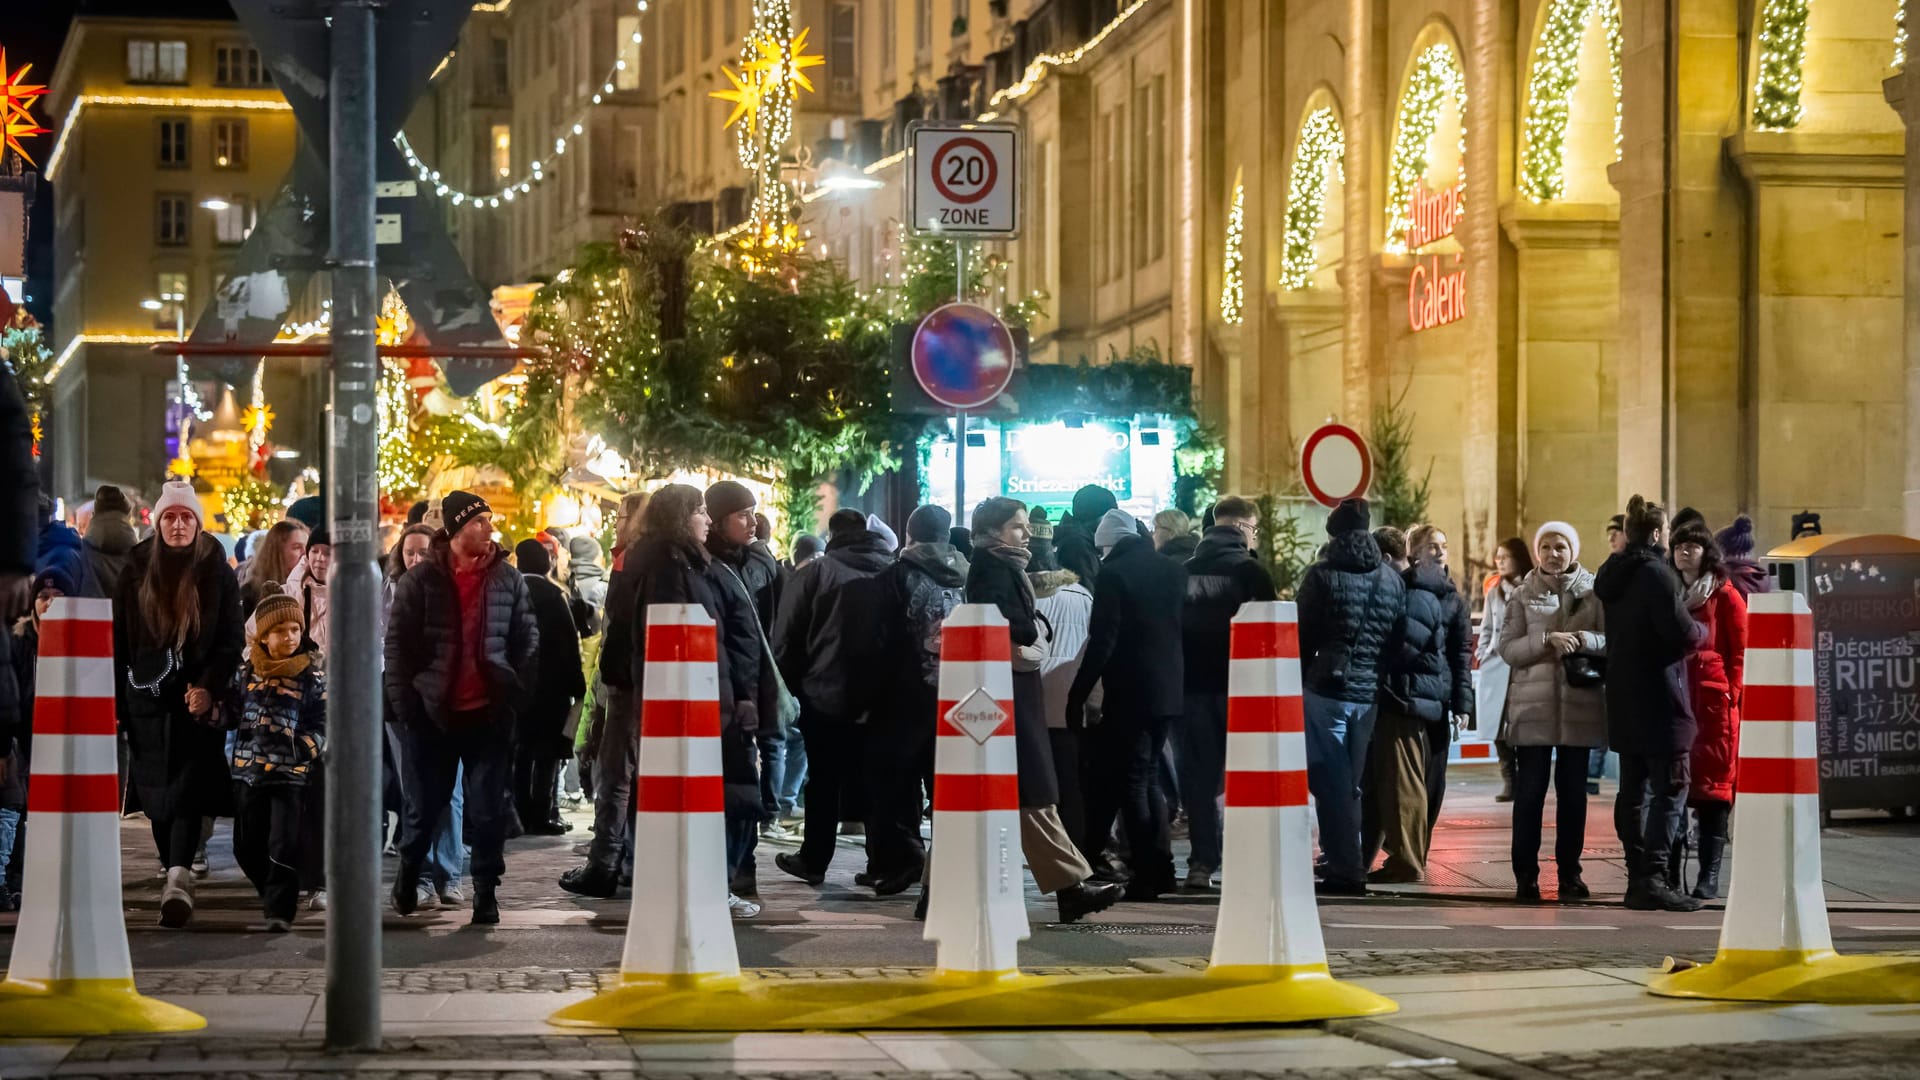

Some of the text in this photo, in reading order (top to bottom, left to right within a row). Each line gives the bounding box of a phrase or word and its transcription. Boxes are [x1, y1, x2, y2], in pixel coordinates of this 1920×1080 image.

[948, 157, 983, 185] 20
[940, 208, 989, 225] ZONE
[957, 710, 1003, 723] CitySafe
